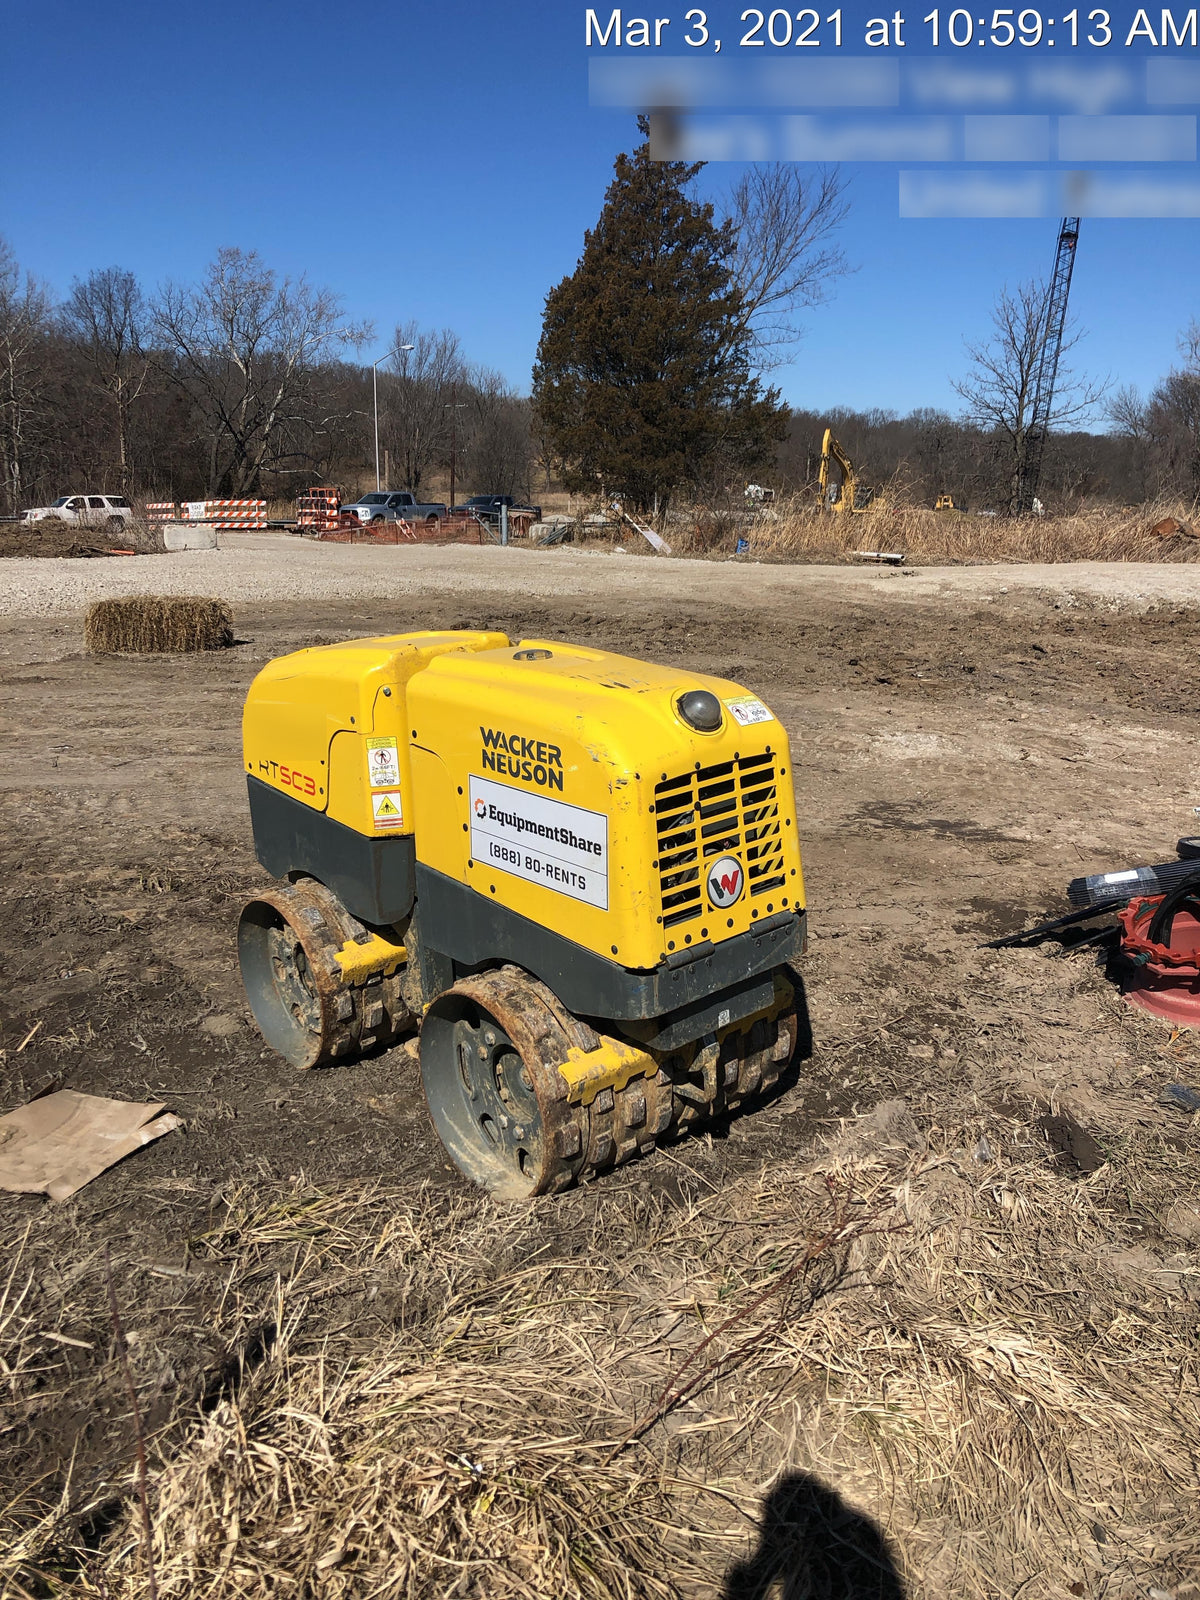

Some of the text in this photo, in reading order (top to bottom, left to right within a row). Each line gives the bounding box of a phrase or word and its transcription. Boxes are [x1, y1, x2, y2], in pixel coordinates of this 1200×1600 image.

[480, 727, 563, 768] WACKER
[482, 749, 564, 792] NEUSON
[488, 804, 602, 857] EquipmentShare
[489, 841, 587, 890] (888) 80-RENTS
[709, 869, 740, 900] W
